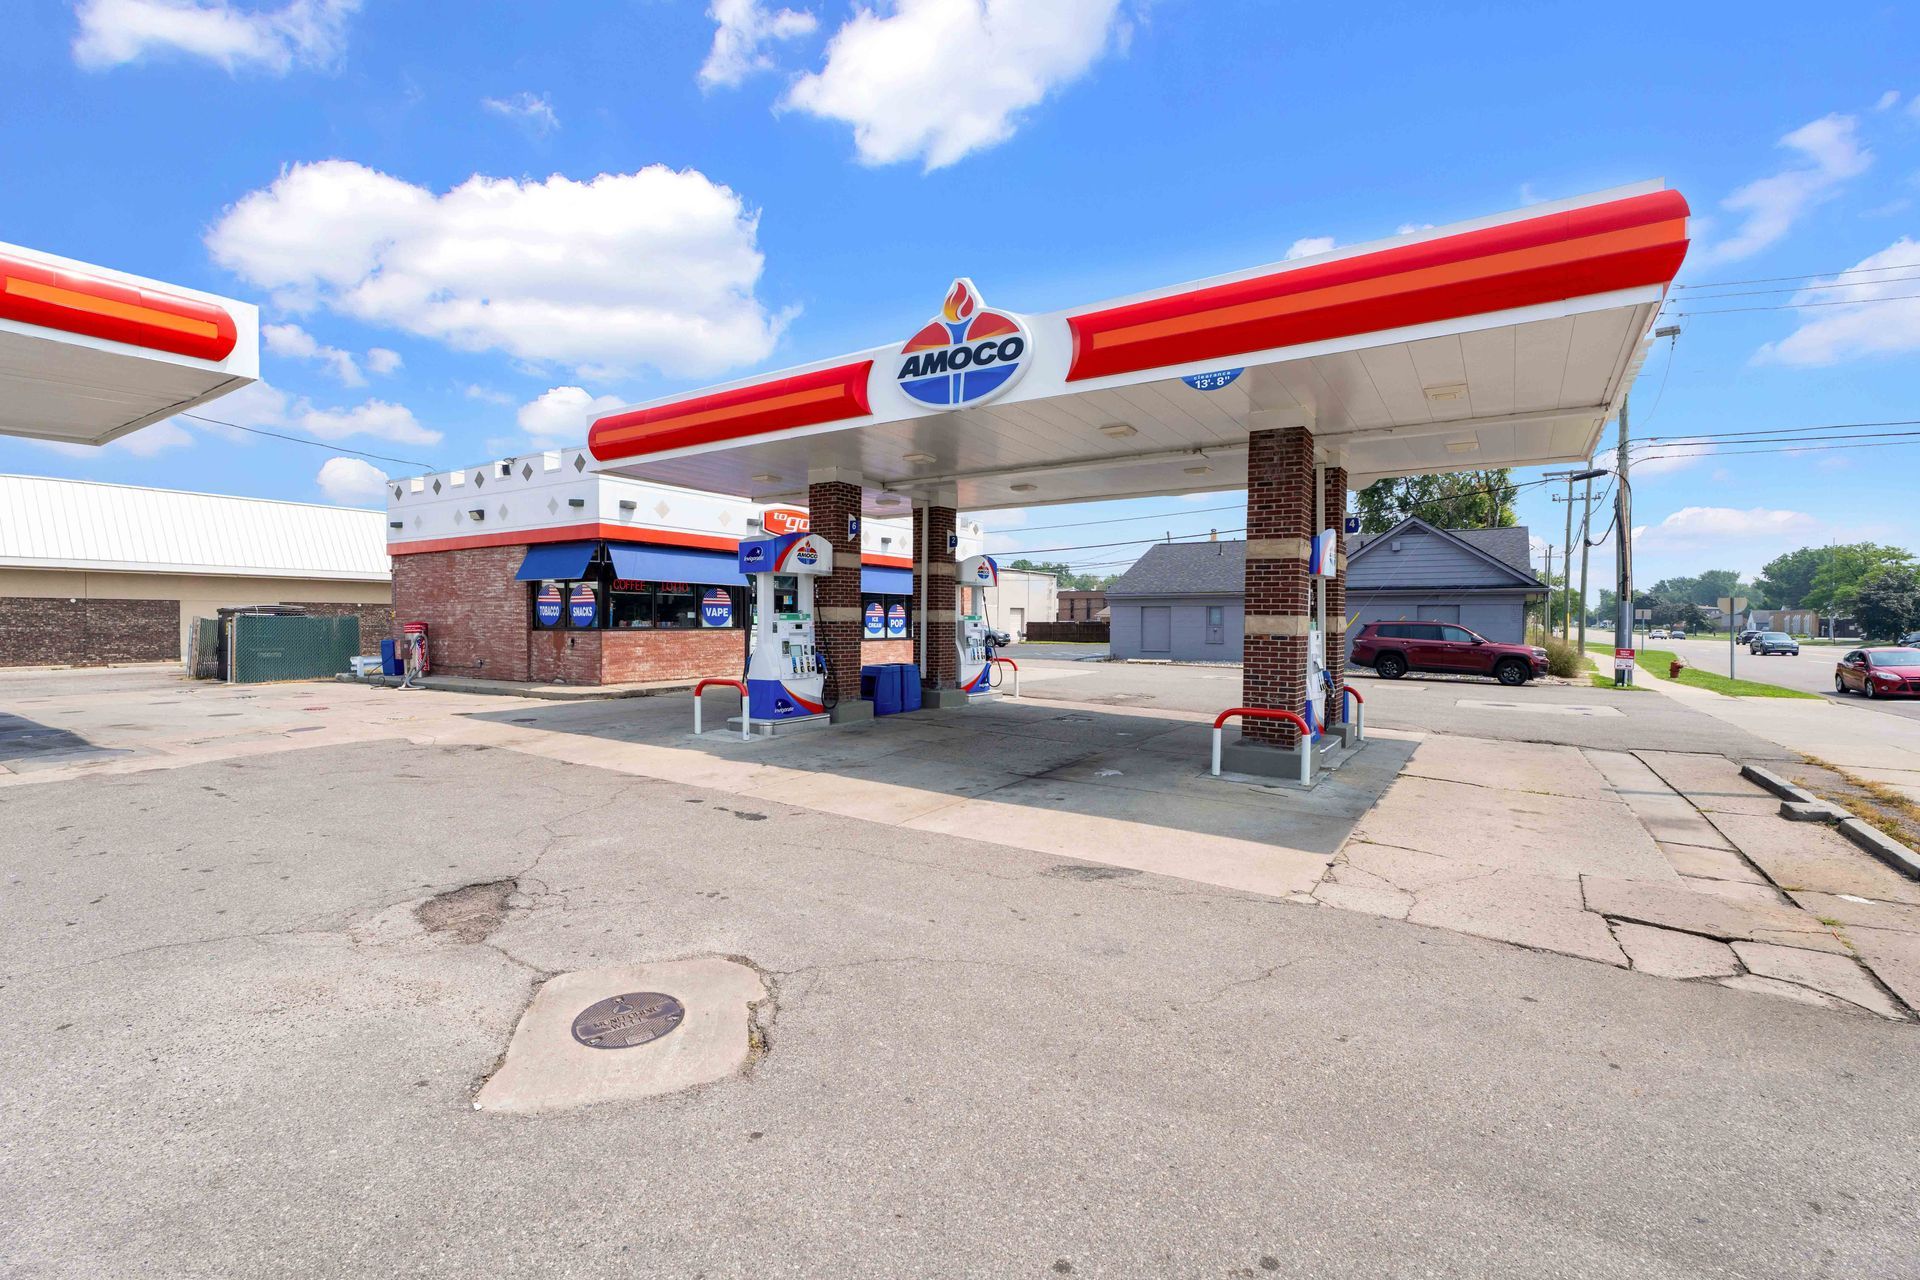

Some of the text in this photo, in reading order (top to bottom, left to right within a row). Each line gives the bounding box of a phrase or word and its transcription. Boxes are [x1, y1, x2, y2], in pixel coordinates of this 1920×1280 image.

[897, 336, 1024, 379] AMOCO
[1193, 371, 1231, 380] clearance
[773, 512, 810, 533] to go
[852, 522, 857, 530] 6
[1348, 519, 1355, 528] 4
[951, 536, 956, 544] 2
[613, 579, 646, 591] COFFEE
[661, 581, 689, 593] LOTTO
[539, 605, 560, 617] TOBACCO
[572, 606, 593, 617] SNACKS
[705, 607, 729, 617] VAPE
[890, 619, 904, 628] POP
